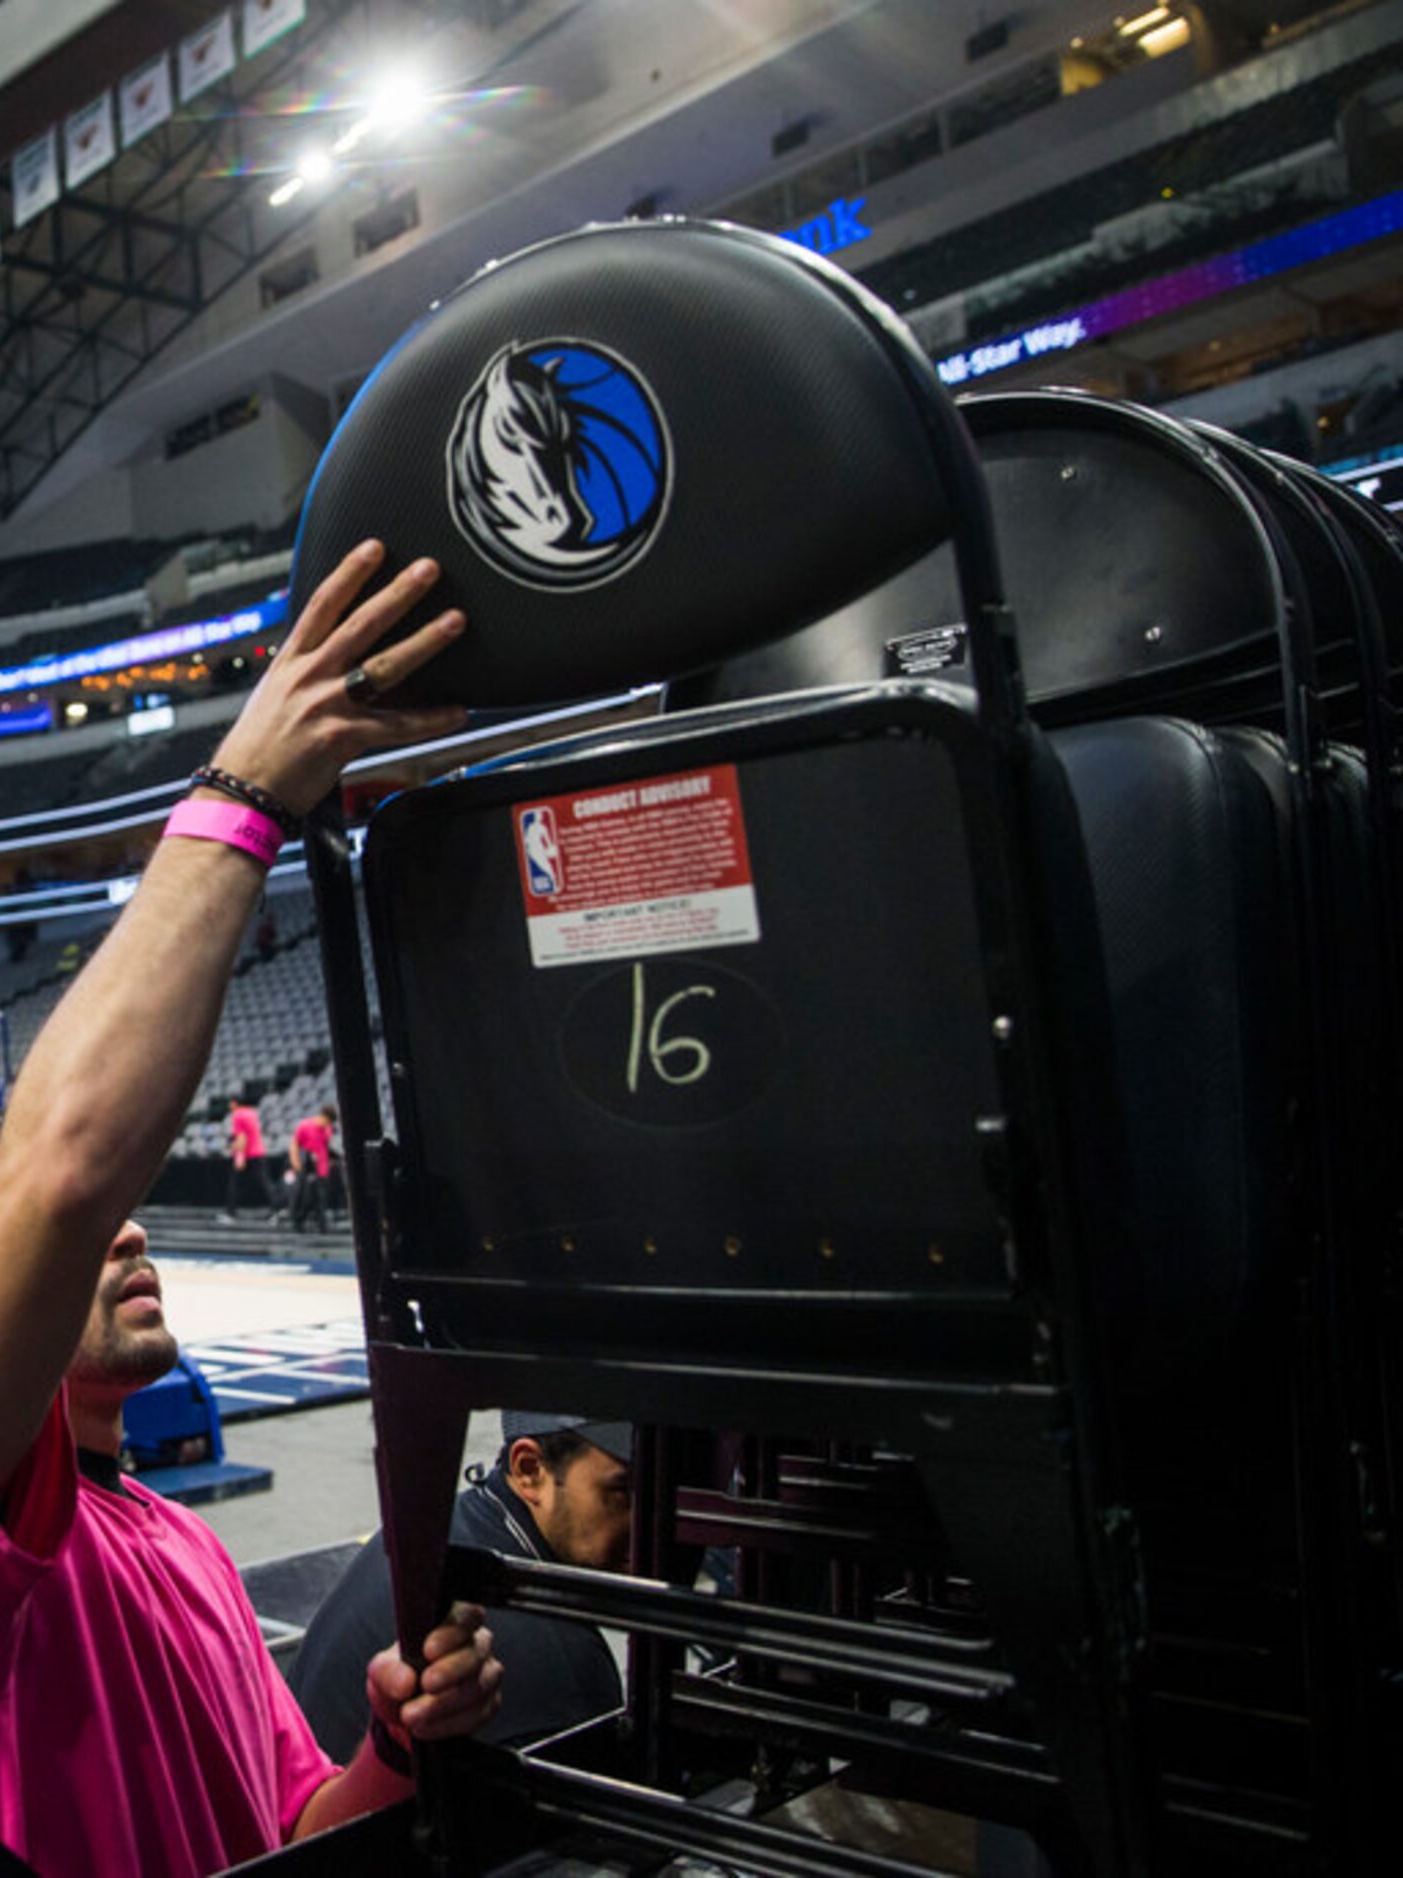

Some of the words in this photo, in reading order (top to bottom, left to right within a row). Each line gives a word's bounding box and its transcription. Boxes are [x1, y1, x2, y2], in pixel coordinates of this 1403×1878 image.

[777, 197, 873, 256] nk
[572, 788, 637, 820] CONDUCT
[640, 775, 711, 806] ADVISORY
[626, 961, 716, 1094] 16
